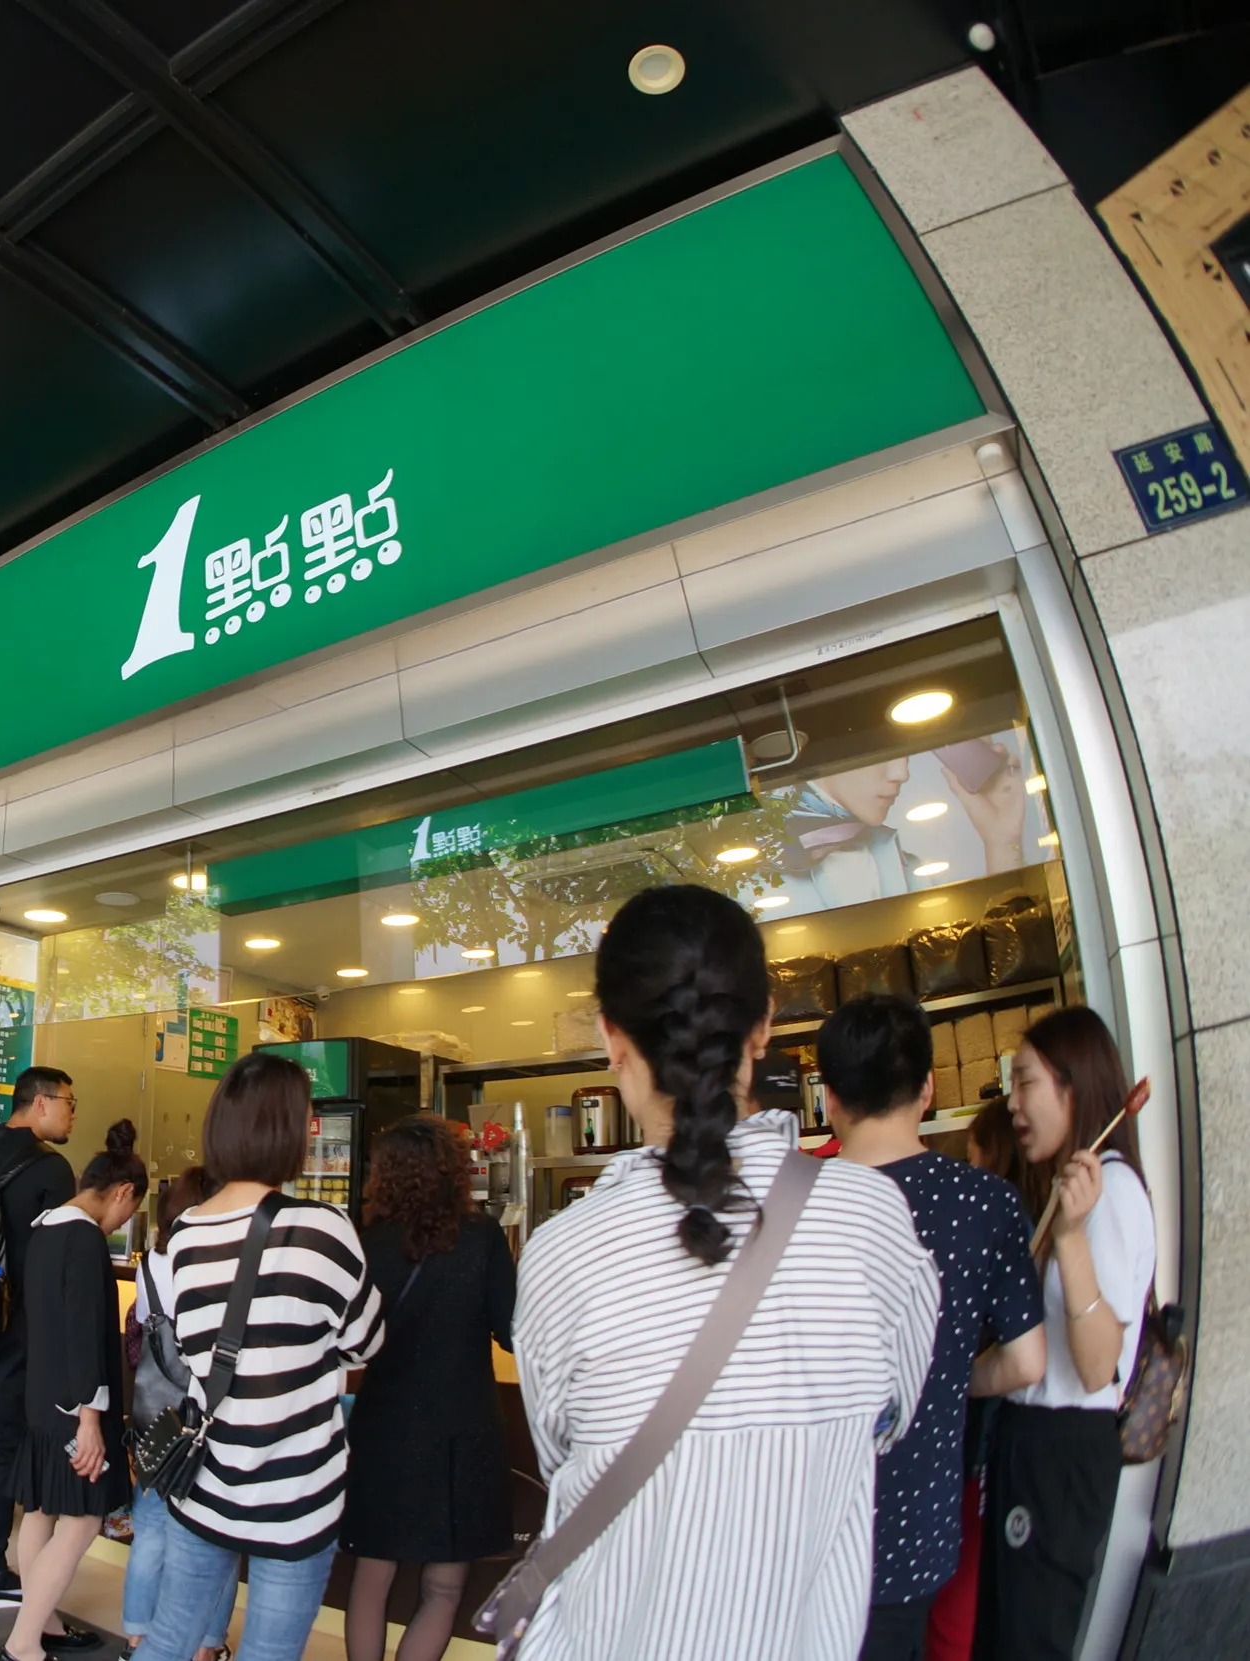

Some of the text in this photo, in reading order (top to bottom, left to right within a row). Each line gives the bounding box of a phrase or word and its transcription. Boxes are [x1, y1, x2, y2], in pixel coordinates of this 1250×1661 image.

[1131, 432, 1214, 474] 延安路
[1148, 461, 1236, 520] 259-2
